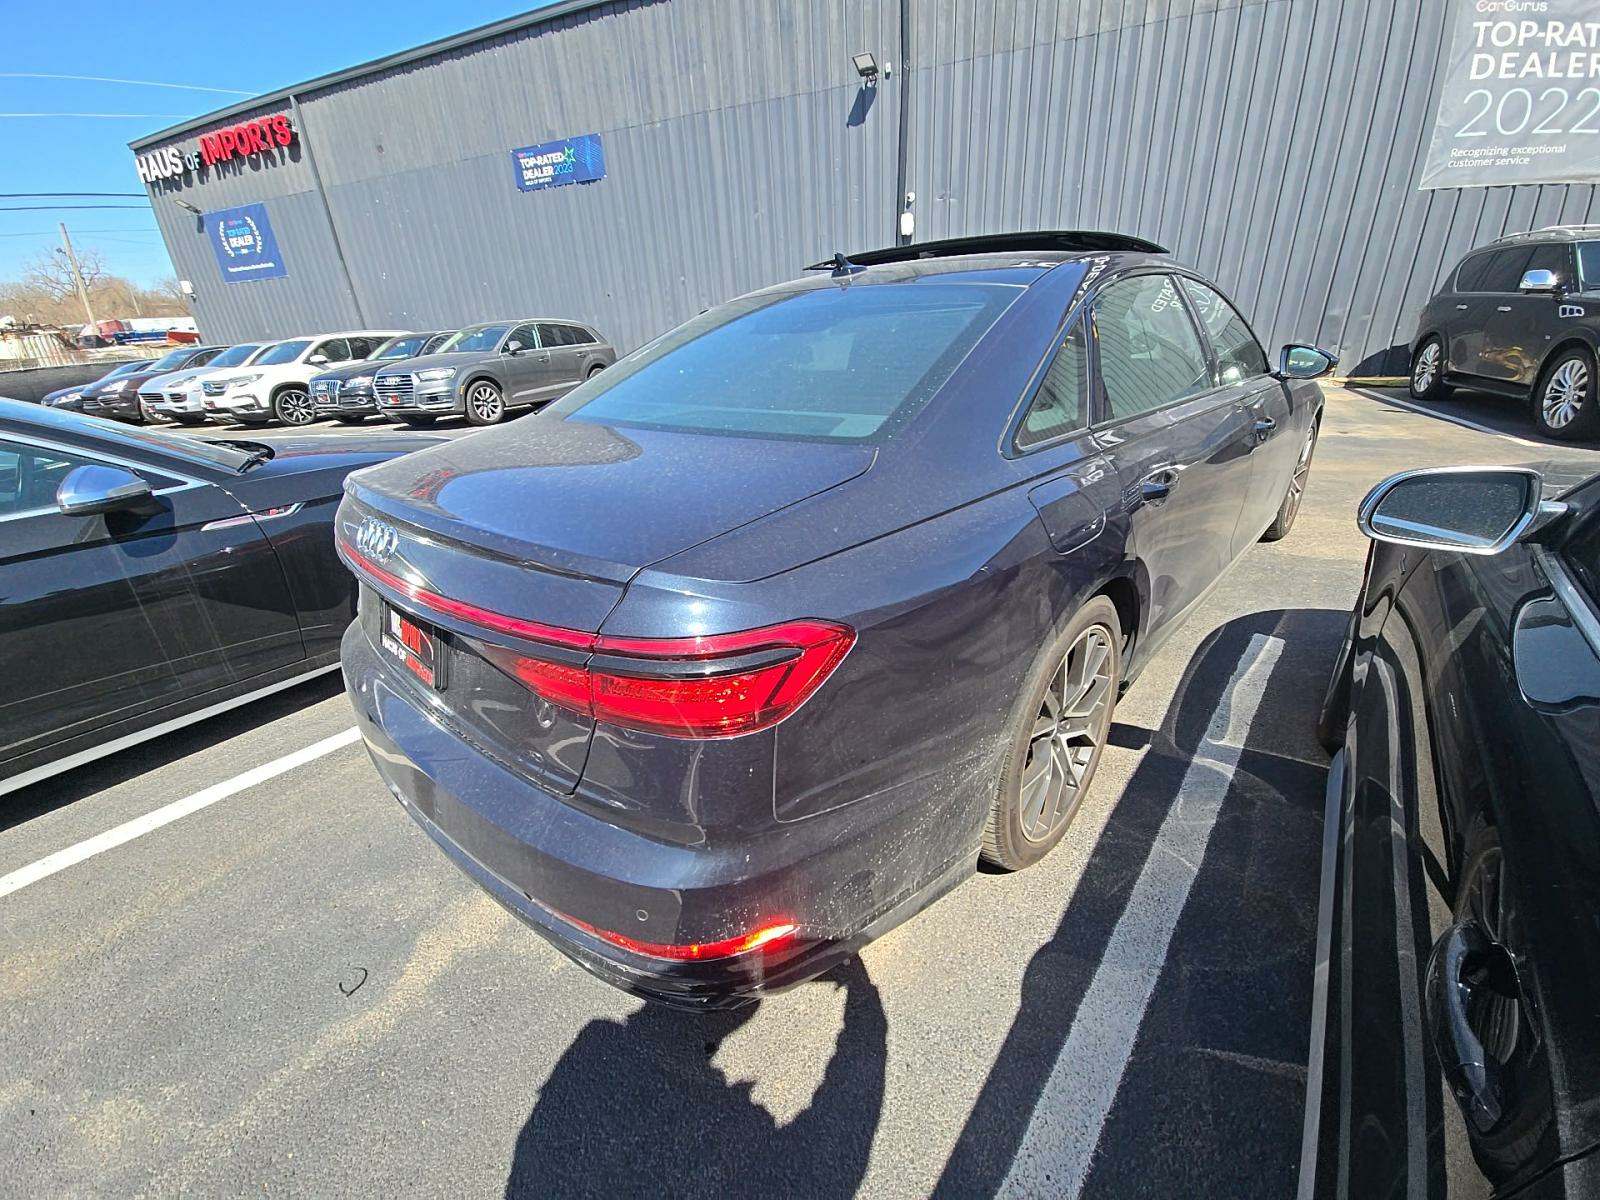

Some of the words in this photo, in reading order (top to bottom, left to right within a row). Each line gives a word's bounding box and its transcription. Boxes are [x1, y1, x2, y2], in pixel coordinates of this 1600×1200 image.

[1475, 0, 1548, 13] CarGurus
[1455, 88, 1600, 137] 2022
[135, 147, 184, 183] HAUS
[185, 151, 201, 171] OF
[200, 115, 291, 166] IMPORTS
[1450, 145, 1509, 158] Recognizing
[1511, 144, 1567, 155] exceptional
[1447, 157, 1495, 169] customer
[1494, 156, 1530, 166] service
[523, 166, 554, 179] DEALER
[555, 163, 573, 175] 2023
